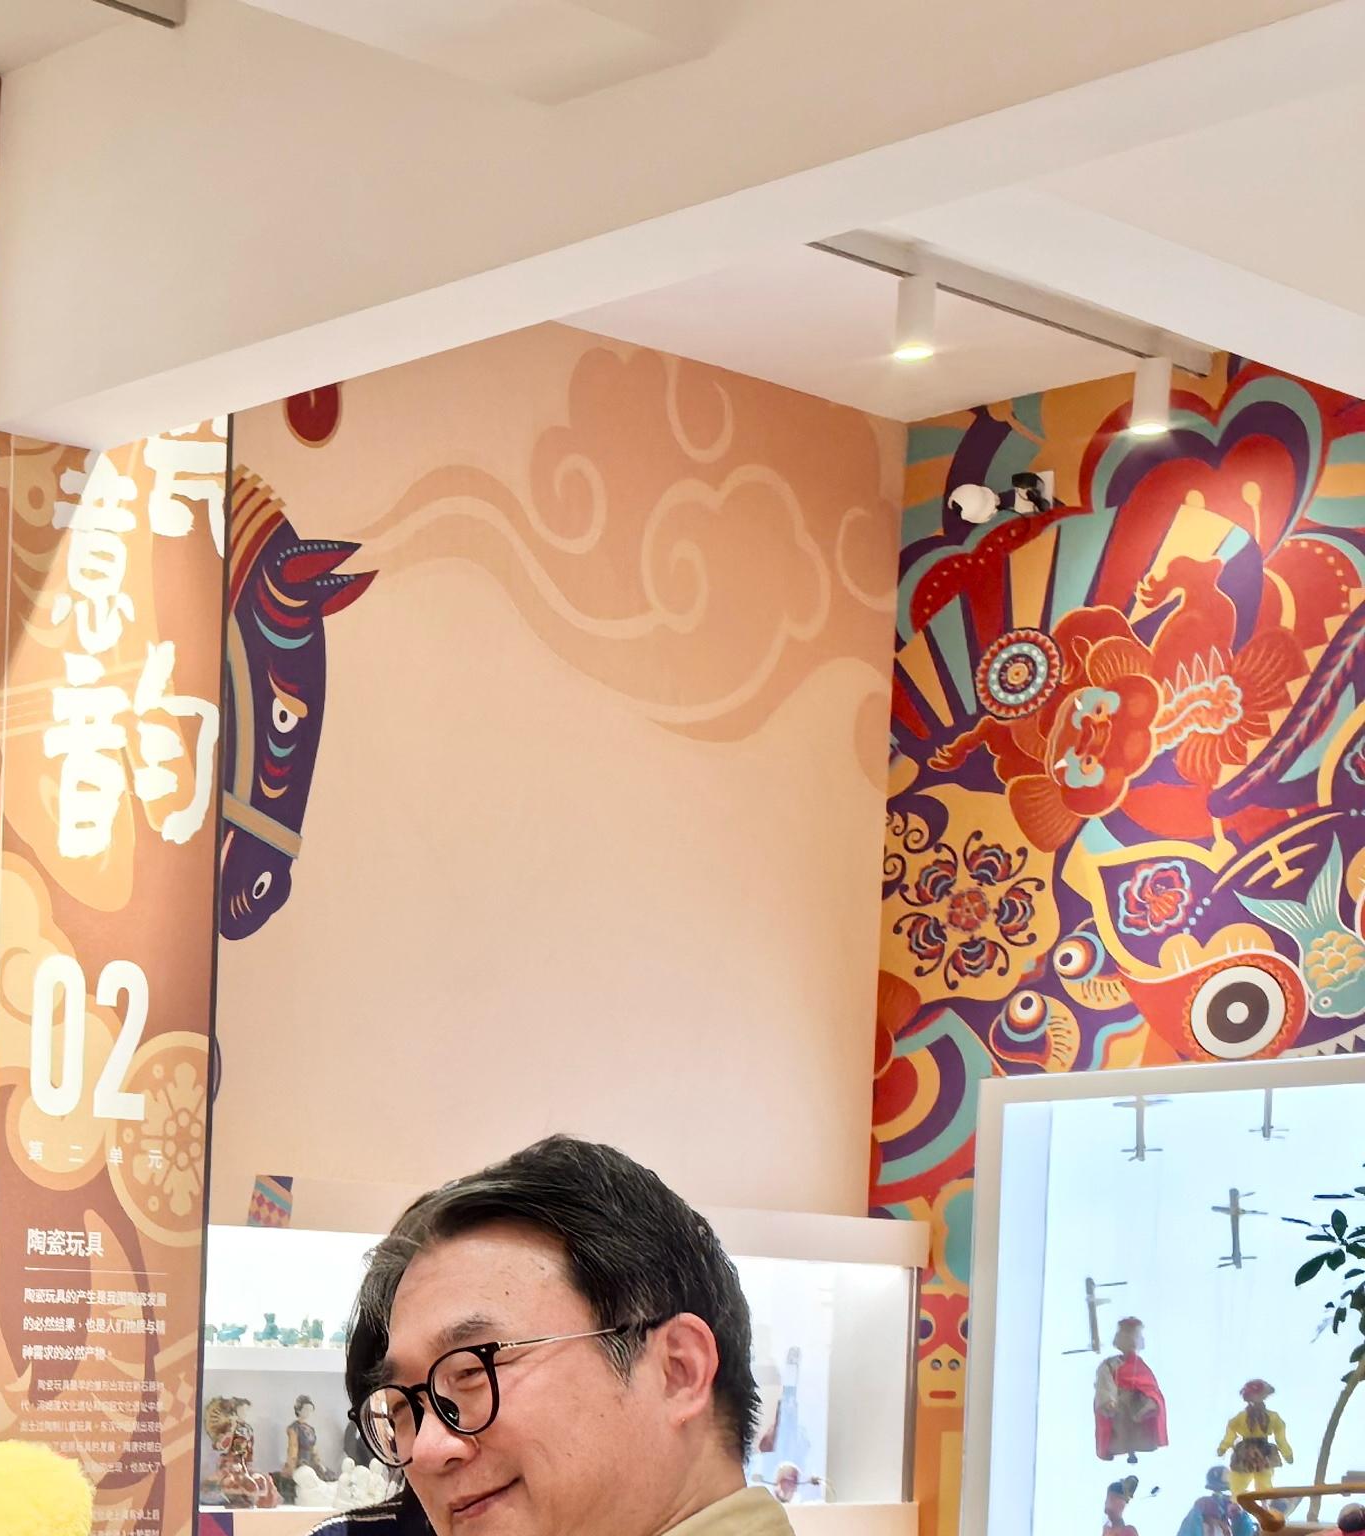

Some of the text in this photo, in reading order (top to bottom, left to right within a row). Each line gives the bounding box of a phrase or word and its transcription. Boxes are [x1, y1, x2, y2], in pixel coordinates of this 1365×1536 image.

[30, 954, 149, 1121] 02
[27, 1140, 164, 1171] 第二单元
[26, 1228, 104, 1257] 陶瓷玩具
